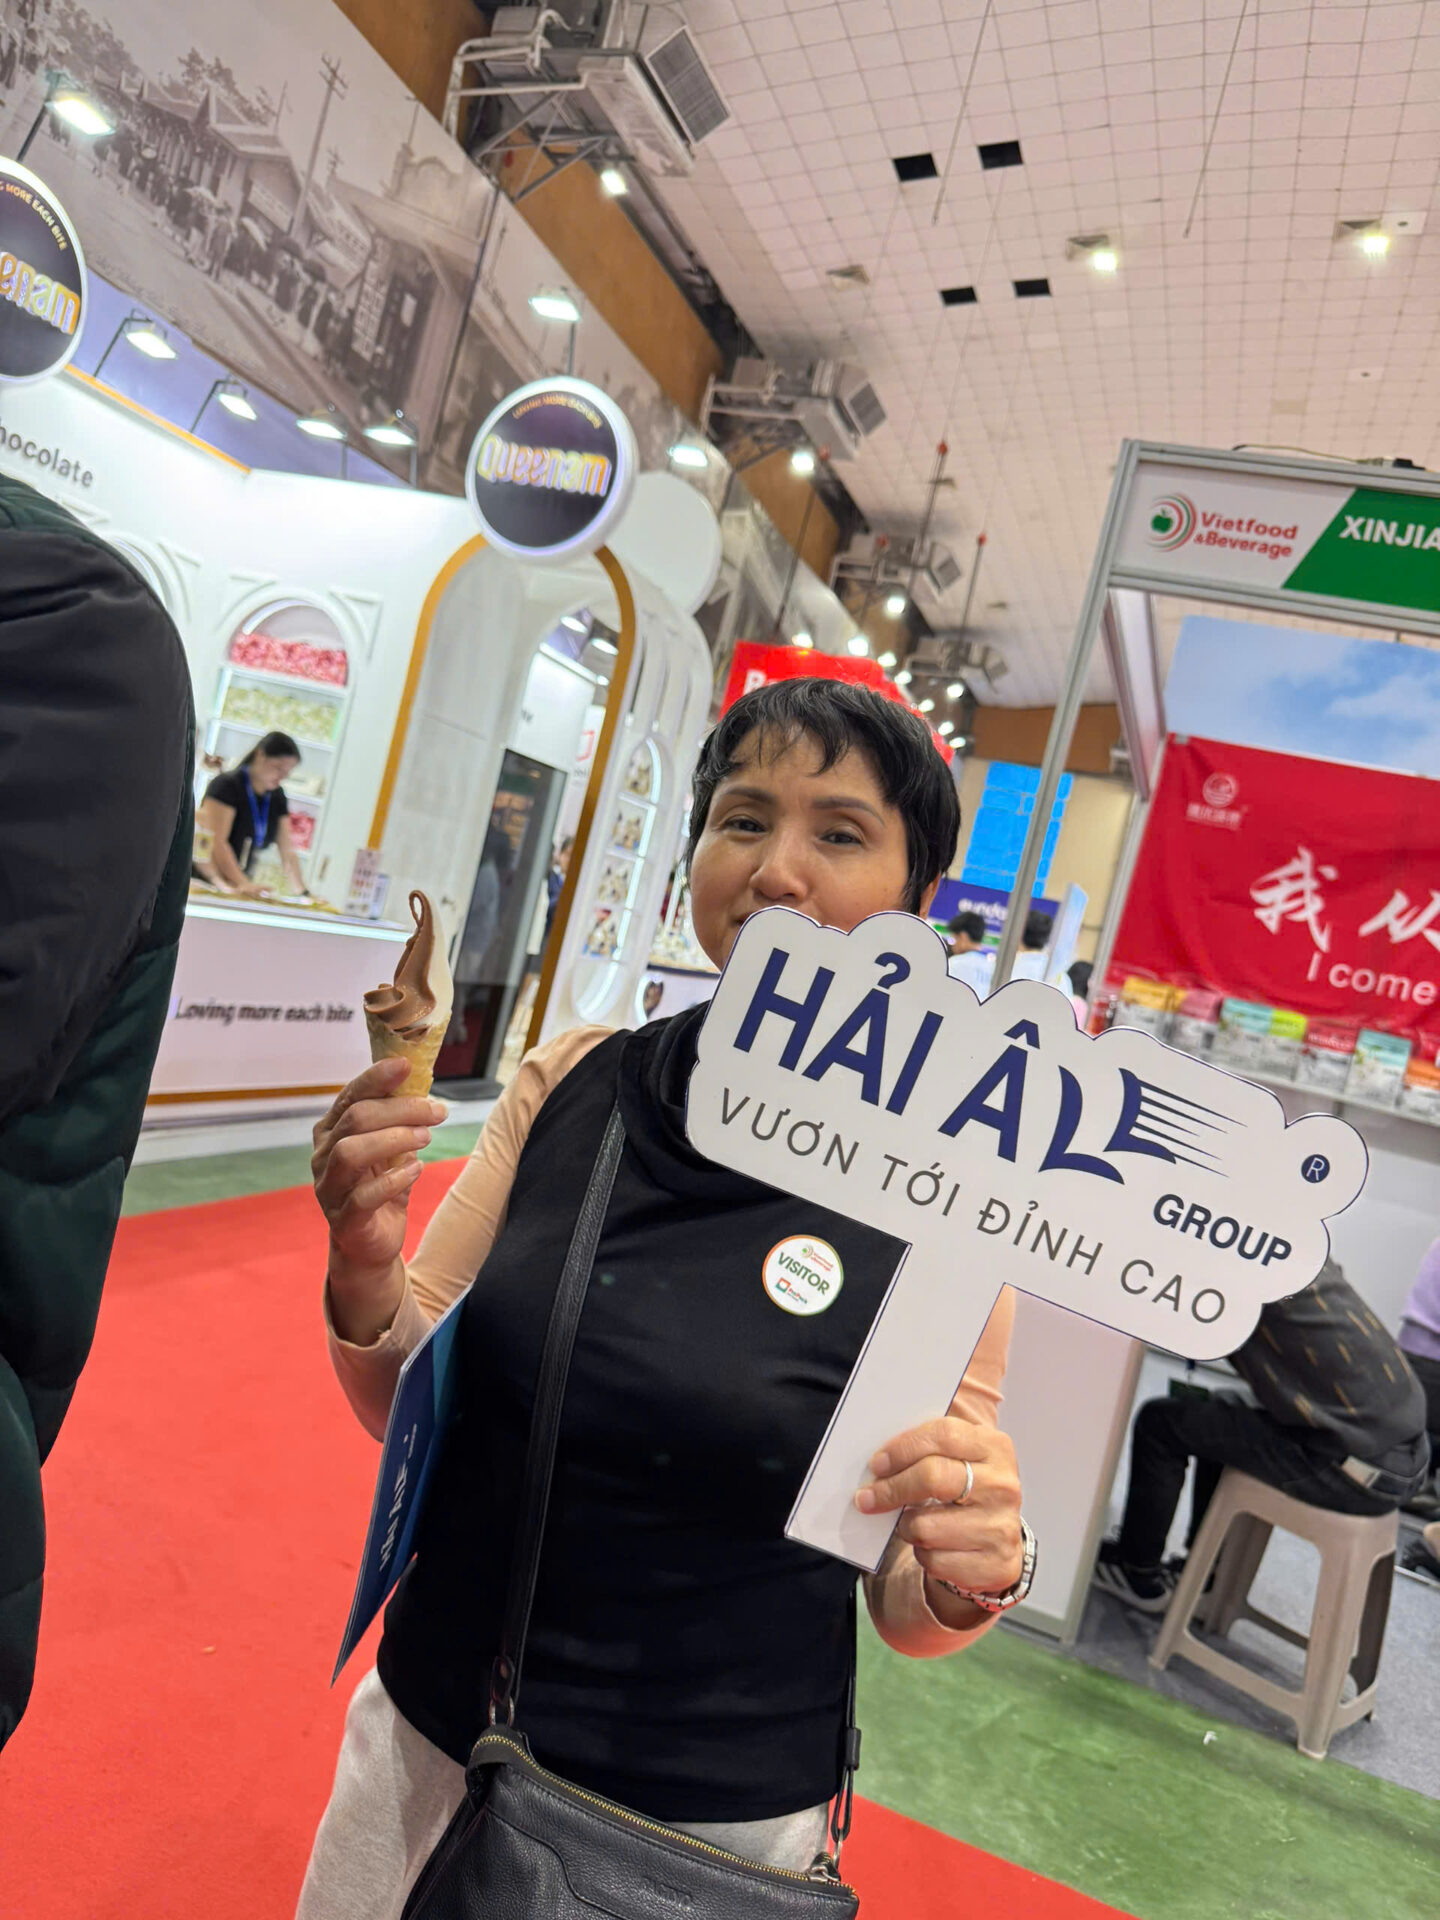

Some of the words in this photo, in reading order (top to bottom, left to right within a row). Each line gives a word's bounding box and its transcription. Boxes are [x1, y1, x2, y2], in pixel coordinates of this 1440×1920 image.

[477, 433, 612, 497] Queenam
[1193, 529, 1293, 560] &Beverage
[1200, 510, 1298, 540] Vietfood
[1306, 951, 1322, 982] I
[1328, 963, 1436, 1006] come
[733, 947, 944, 1116] HẢI
[721, 1087, 859, 1175] VƯƠN
[881, 1153, 960, 1217] TỚI
[977, 1196, 1103, 1276] ĐỈNH
[1120, 1259, 1226, 1324] CAO
[1153, 1193, 1292, 1267] GROUP
[778, 1251, 830, 1296] VISITOR
